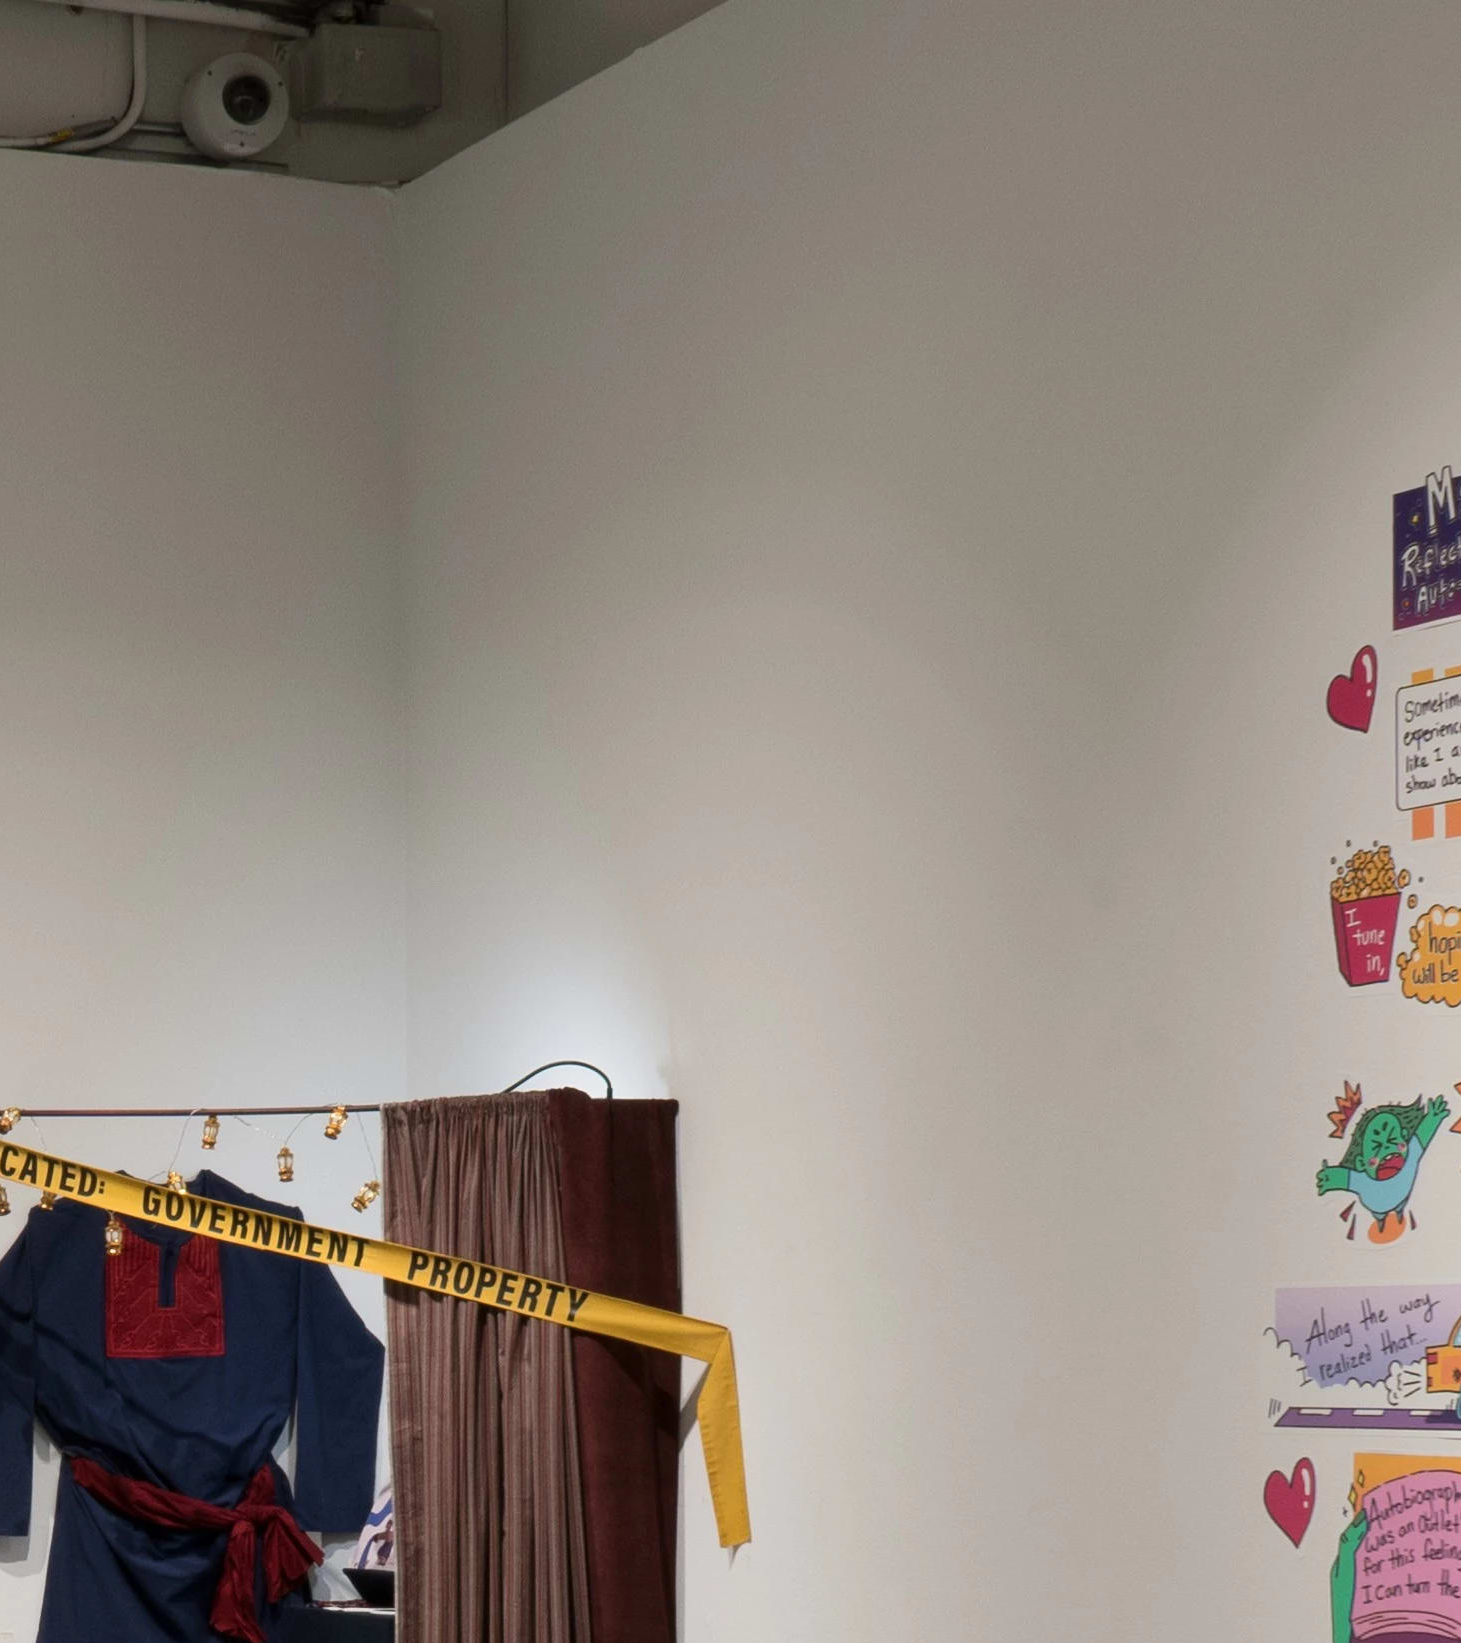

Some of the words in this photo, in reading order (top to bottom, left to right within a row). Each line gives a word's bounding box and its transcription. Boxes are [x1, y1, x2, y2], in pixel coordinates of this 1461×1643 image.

[1406, 755, 1429, 772] like
[1406, 775, 1436, 793] show
[1353, 928, 1385, 946] tune
[1366, 953, 1384, 977] in,
[1412, 960, 1436, 984] will
[1441, 957, 1460, 984] be
[142, 1184, 370, 1267] GOVERNMENT
[407, 1251, 590, 1322] PROPERTY
[1305, 1307, 1353, 1354] Along
[1360, 1298, 1388, 1332] the
[1400, 1293, 1439, 1323] way
[1318, 1348, 1373, 1381] realized
[1399, 1520, 1415, 1538] an
[1363, 1556, 1385, 1575] for
[1391, 1546, 1415, 1568] this
[1408, 1577, 1430, 1595] turn
[1438, 1571, 1461, 1599] the
